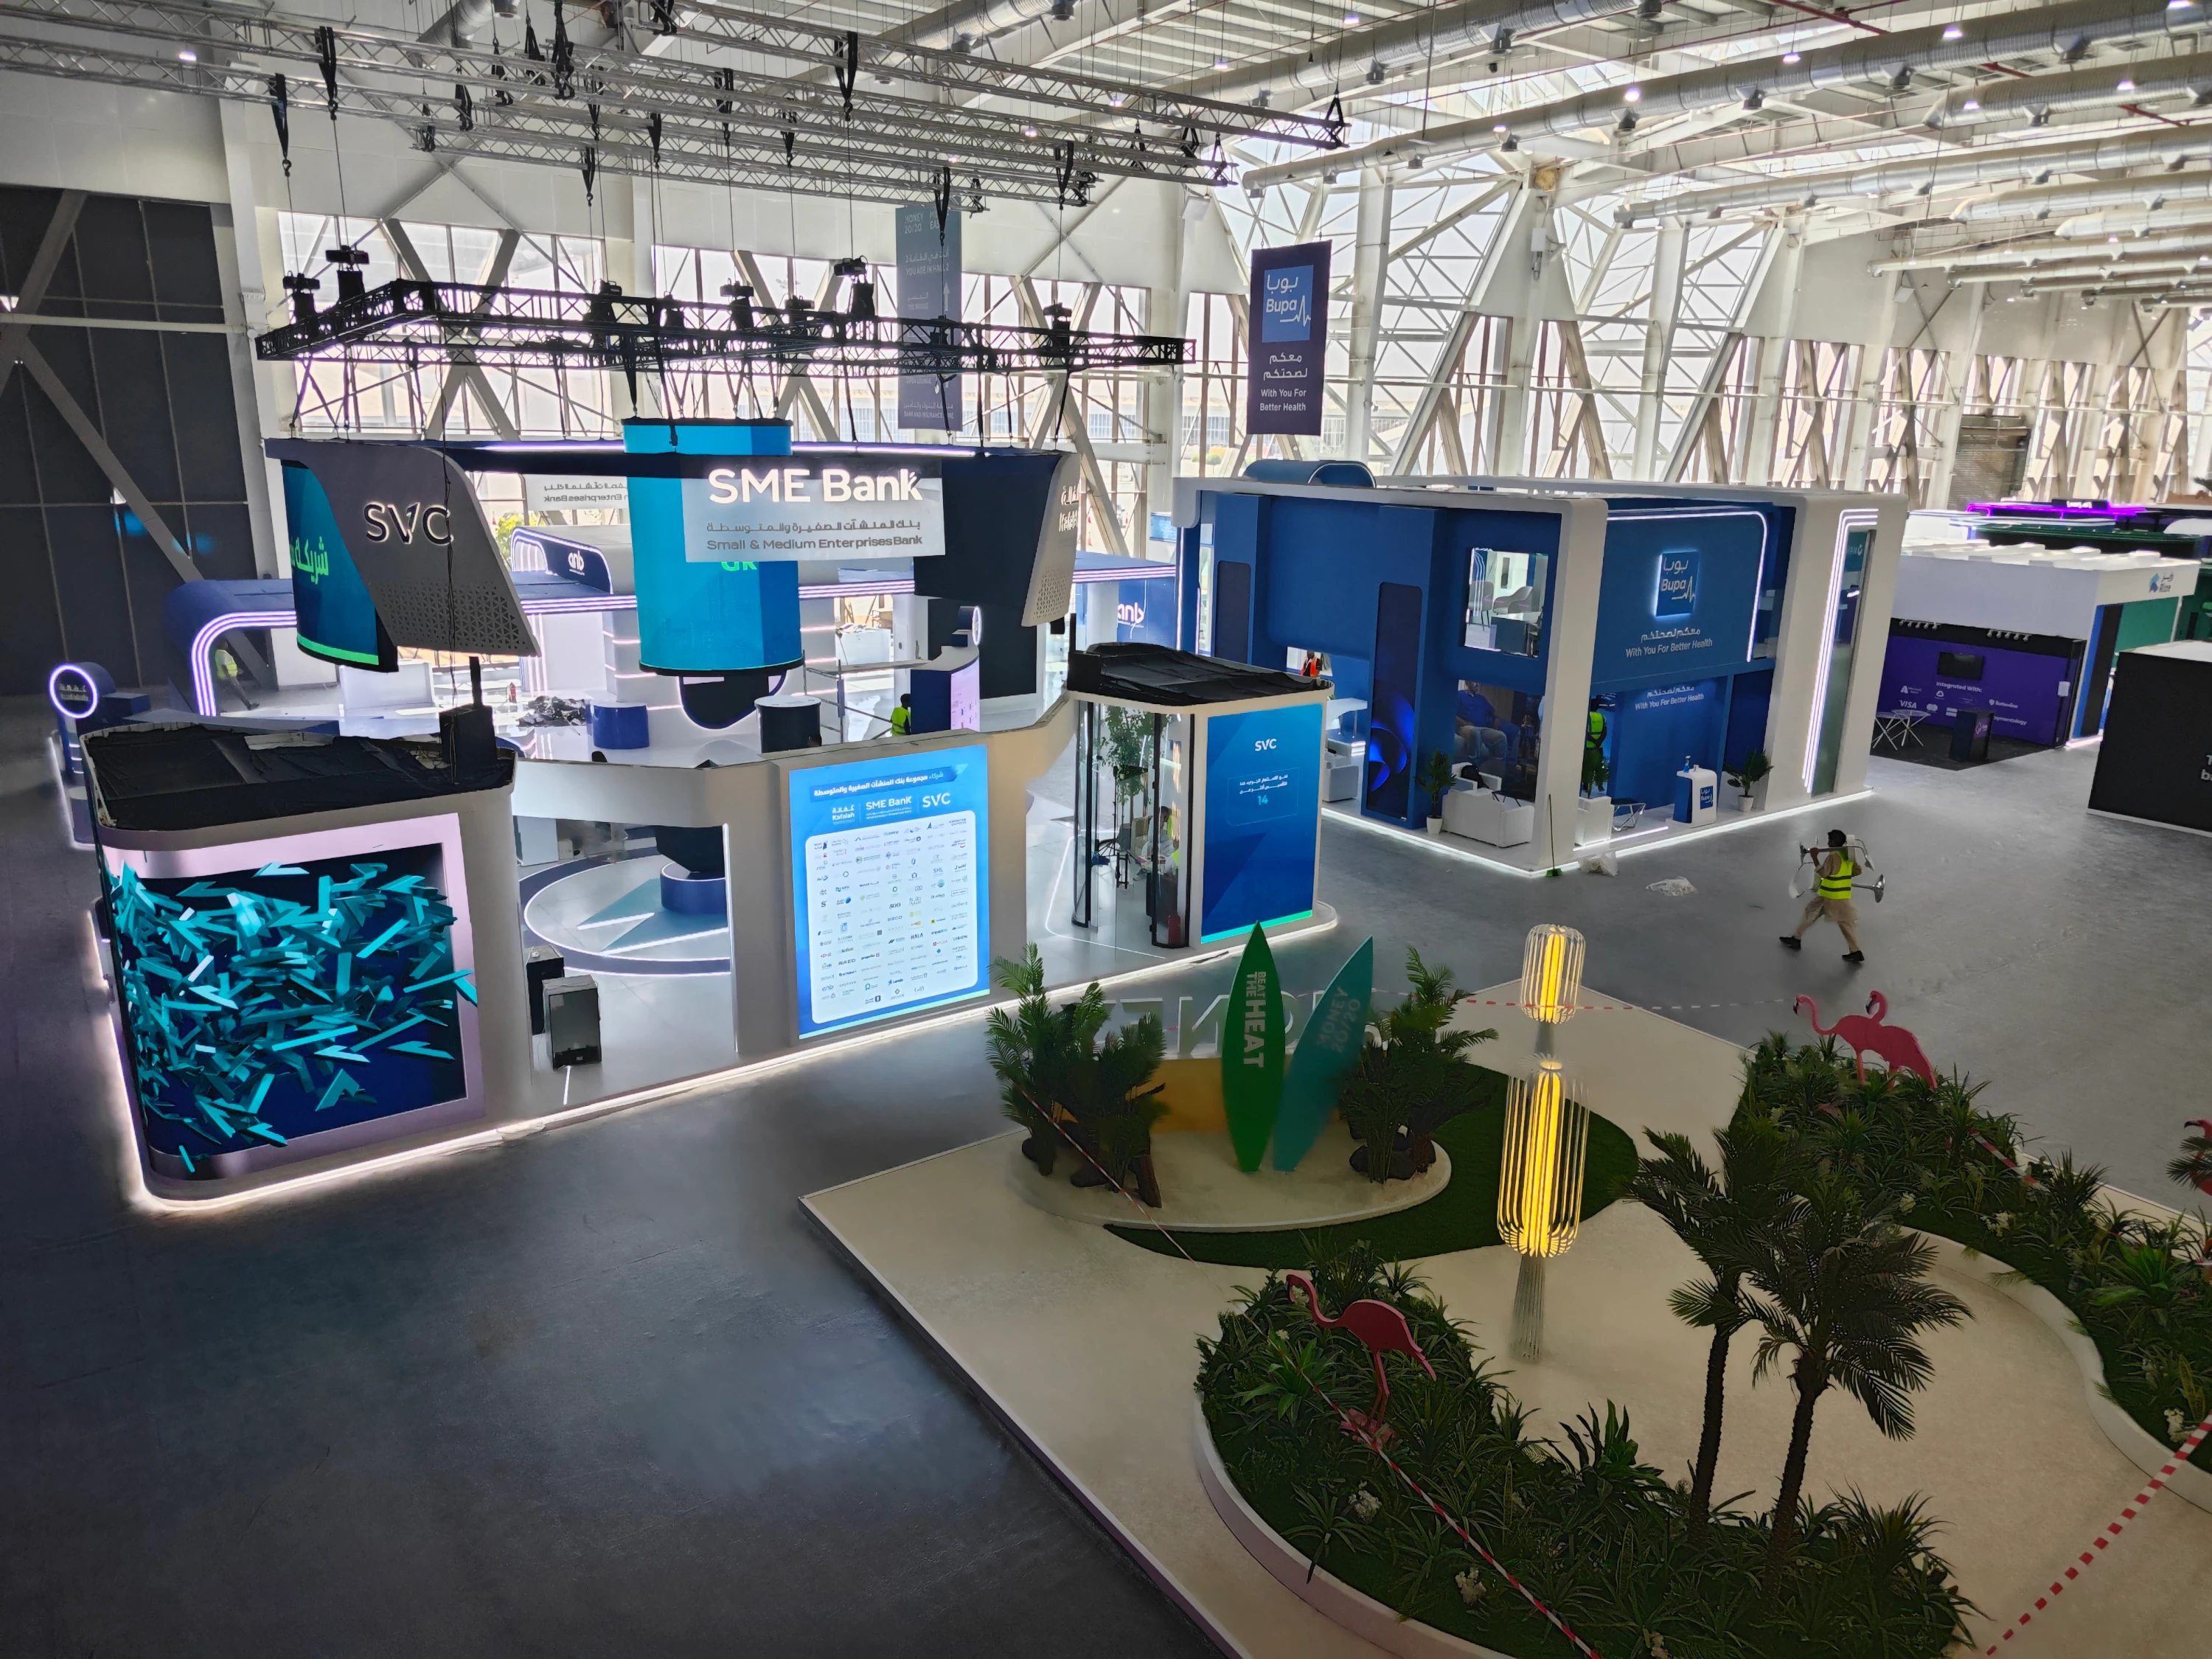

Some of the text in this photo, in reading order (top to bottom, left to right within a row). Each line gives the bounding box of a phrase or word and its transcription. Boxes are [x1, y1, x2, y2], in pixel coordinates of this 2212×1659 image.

[904, 223, 922, 234] 20/20
[905, 267, 917, 276] YOU
[945, 262, 950, 271] 2
[1266, 274, 1298, 293] بوبا
[1266, 298, 1298, 315] Bupa
[1269, 352, 1302, 365] معكم
[1263, 367, 1308, 381] لصحتكم
[1261, 388, 1307, 397] With You For
[1259, 403, 1307, 411] Better Health
[709, 467, 923, 504] SME Bank
[364, 501, 454, 546] SVC
[706, 523, 790, 534] والمتوسطة
[896, 520, 921, 530] بنك
[706, 535, 923, 550] Small & Medium Enterprises Bank
[568, 550, 585, 571] anb
[1663, 557, 1689, 574] بوبا
[1660, 578, 1687, 594] Bupa
[1117, 602, 1145, 624] anb
[1625, 638, 1713, 658] With You For Better Health
[1936, 681, 1966, 690] Integrated
[1635, 693, 1705, 711] With You For Better Health
[1899, 700, 1917, 709] VISA
[1254, 737, 1277, 751] SVC
[866, 796, 912, 810] SME Bank
[922, 792, 951, 808] SVC
[1257, 794, 1269, 806] 14
[832, 812, 855, 821] Kafalah
[1246, 972, 1257, 998] THE
[1258, 971, 1267, 998] BEAT
[1316, 986, 1349, 1048] MONEY
[1243, 999, 1267, 1068] HEAT
[1331, 998, 1361, 1054] 20/20
